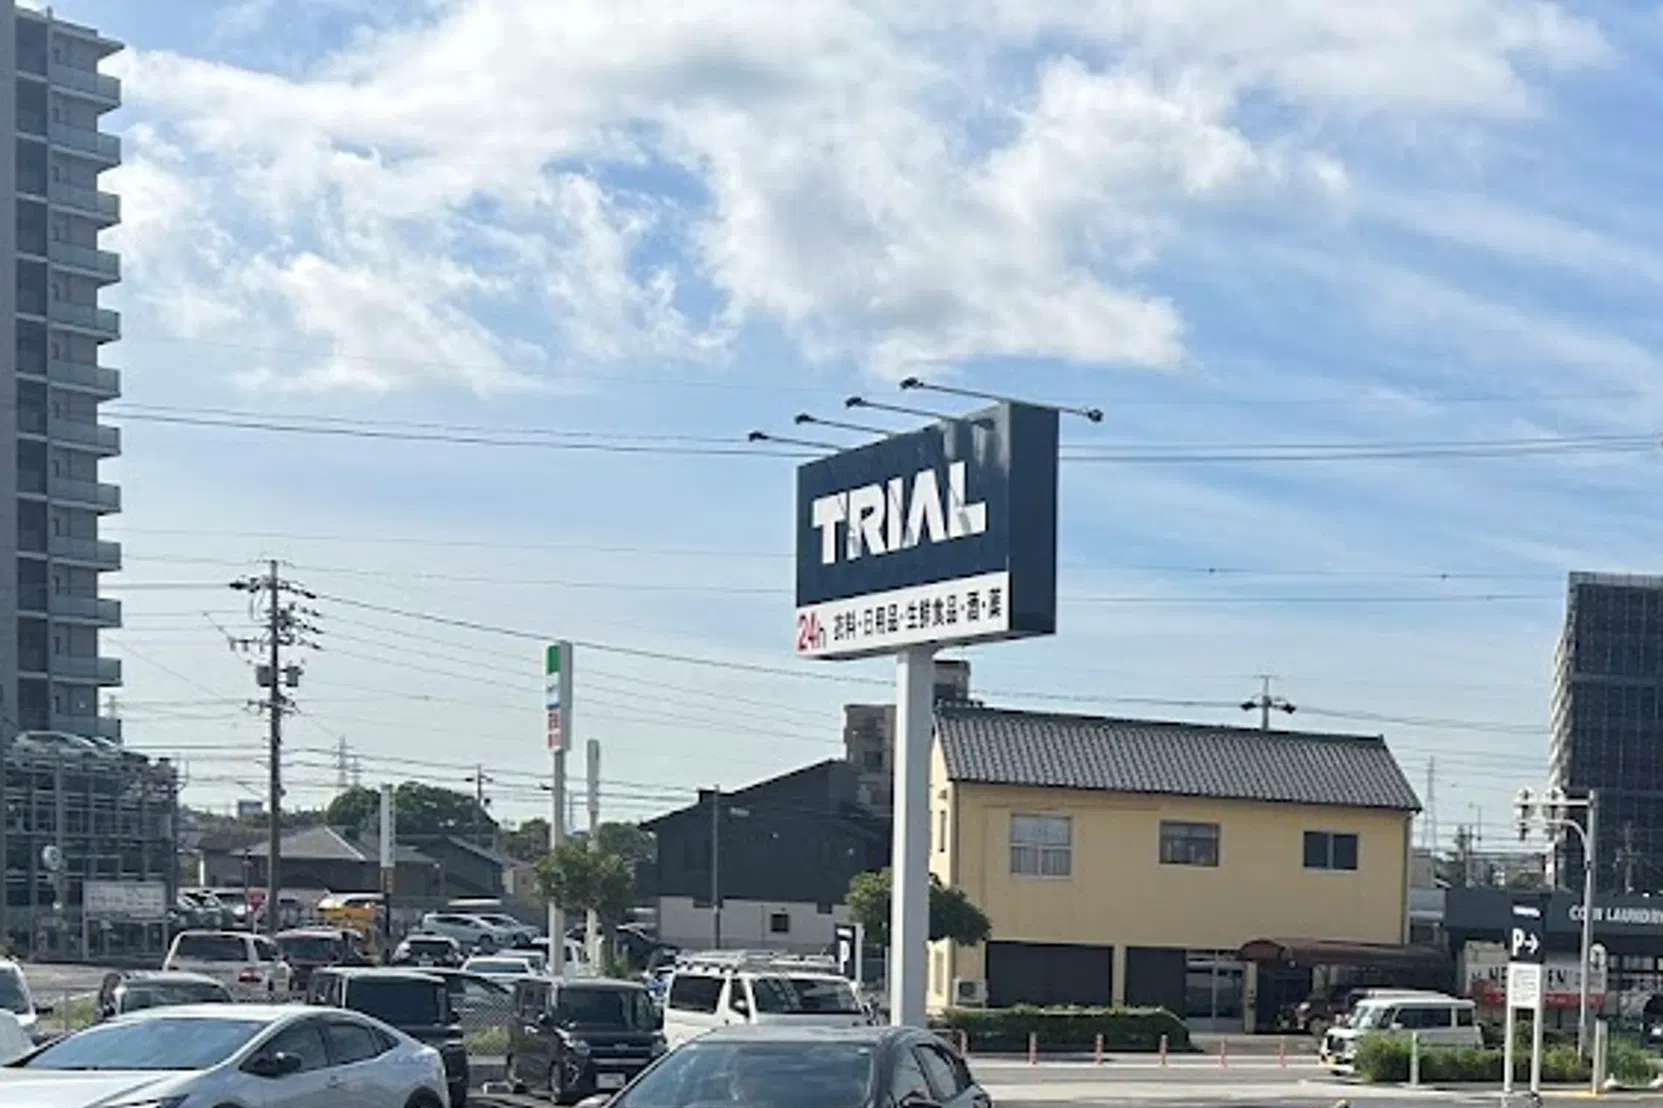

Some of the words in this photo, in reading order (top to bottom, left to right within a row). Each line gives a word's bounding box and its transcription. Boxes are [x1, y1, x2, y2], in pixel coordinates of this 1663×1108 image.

[812, 461, 986, 564] TRIAL
[797, 613, 827, 650] 24h
[1512, 928, 1525, 956] P
